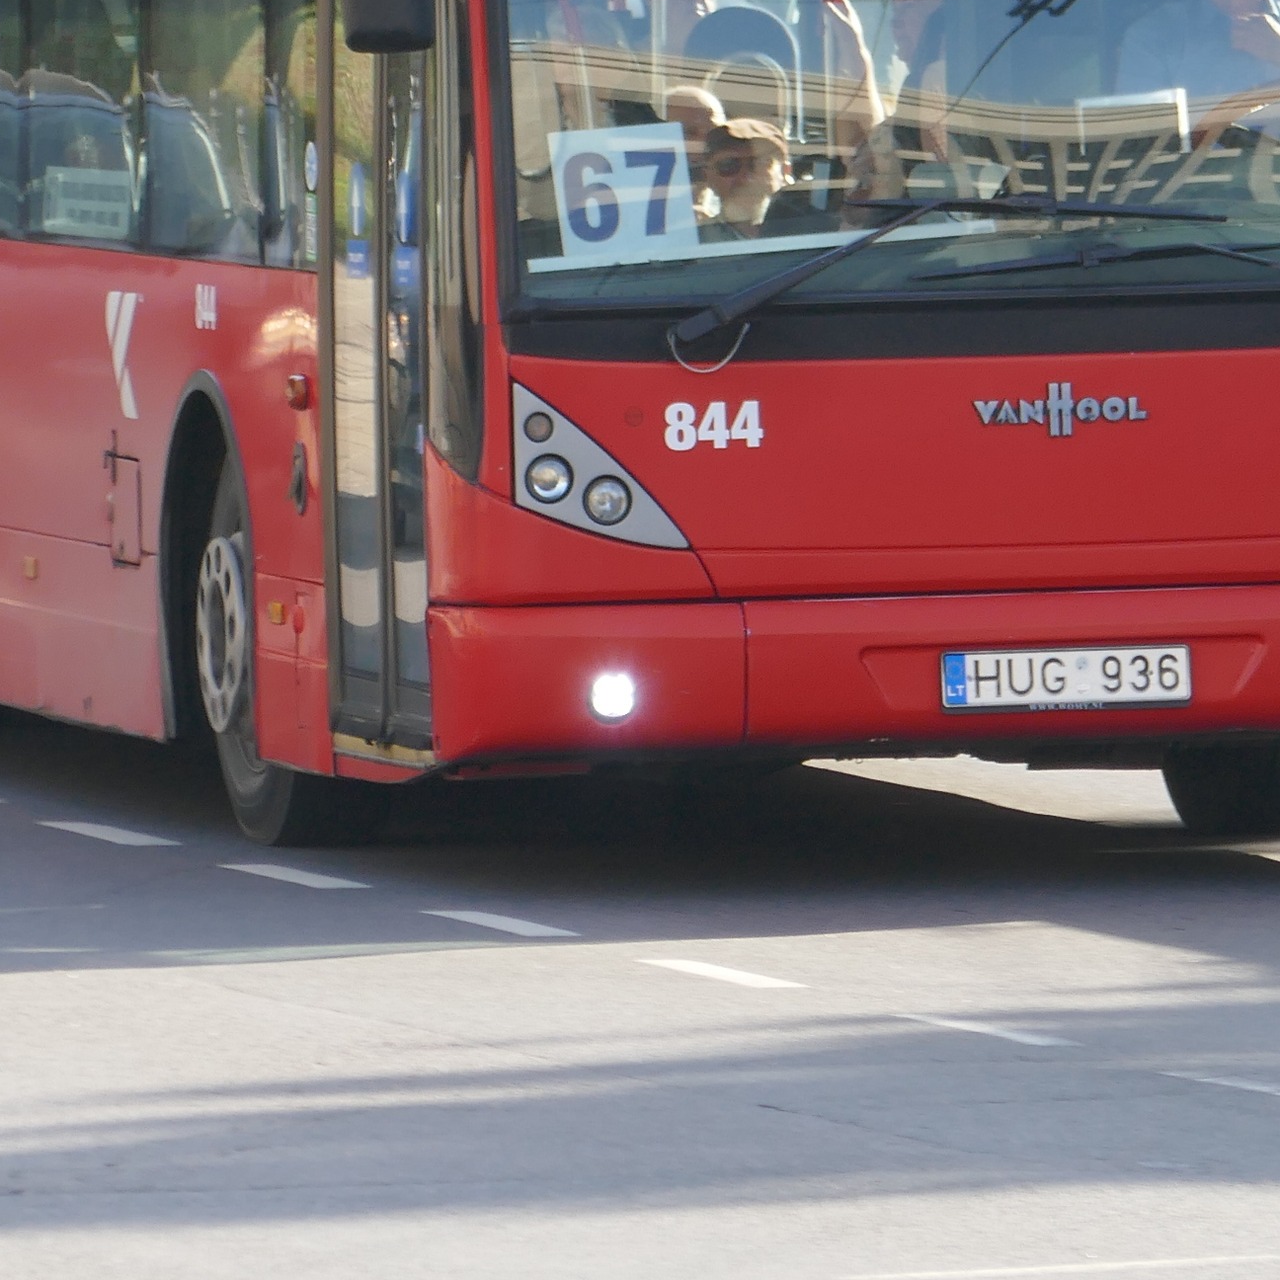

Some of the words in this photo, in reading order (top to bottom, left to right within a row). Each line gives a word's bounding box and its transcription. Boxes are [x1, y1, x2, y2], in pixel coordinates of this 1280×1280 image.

[563, 147, 676, 242] 67
[194, 283, 217, 331] 844
[664, 401, 764, 451] 844
[947, 685, 965, 696] LT
[974, 658, 1066, 698] HUG
[1102, 654, 1180, 692] 936
